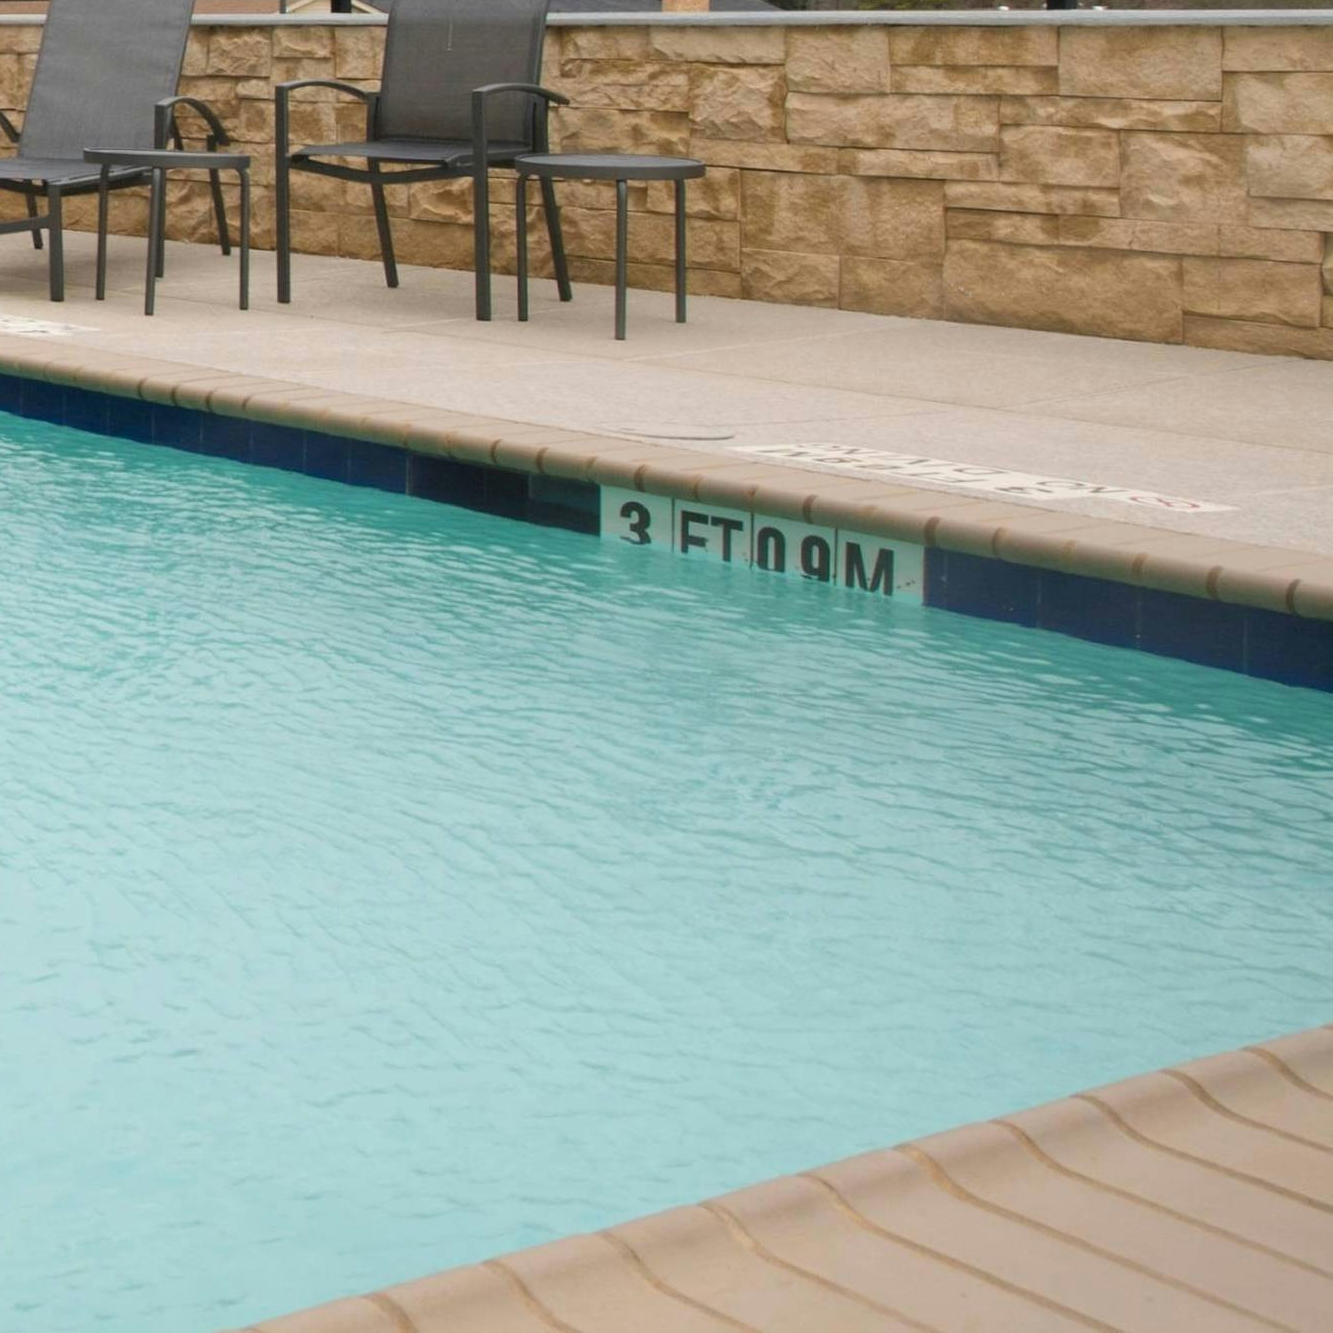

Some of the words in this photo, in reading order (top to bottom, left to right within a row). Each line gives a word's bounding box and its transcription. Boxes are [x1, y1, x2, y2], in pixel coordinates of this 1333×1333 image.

[620, 501, 651, 545] 3
[680, 510, 744, 563] FT
[845, 542, 895, 597] M
